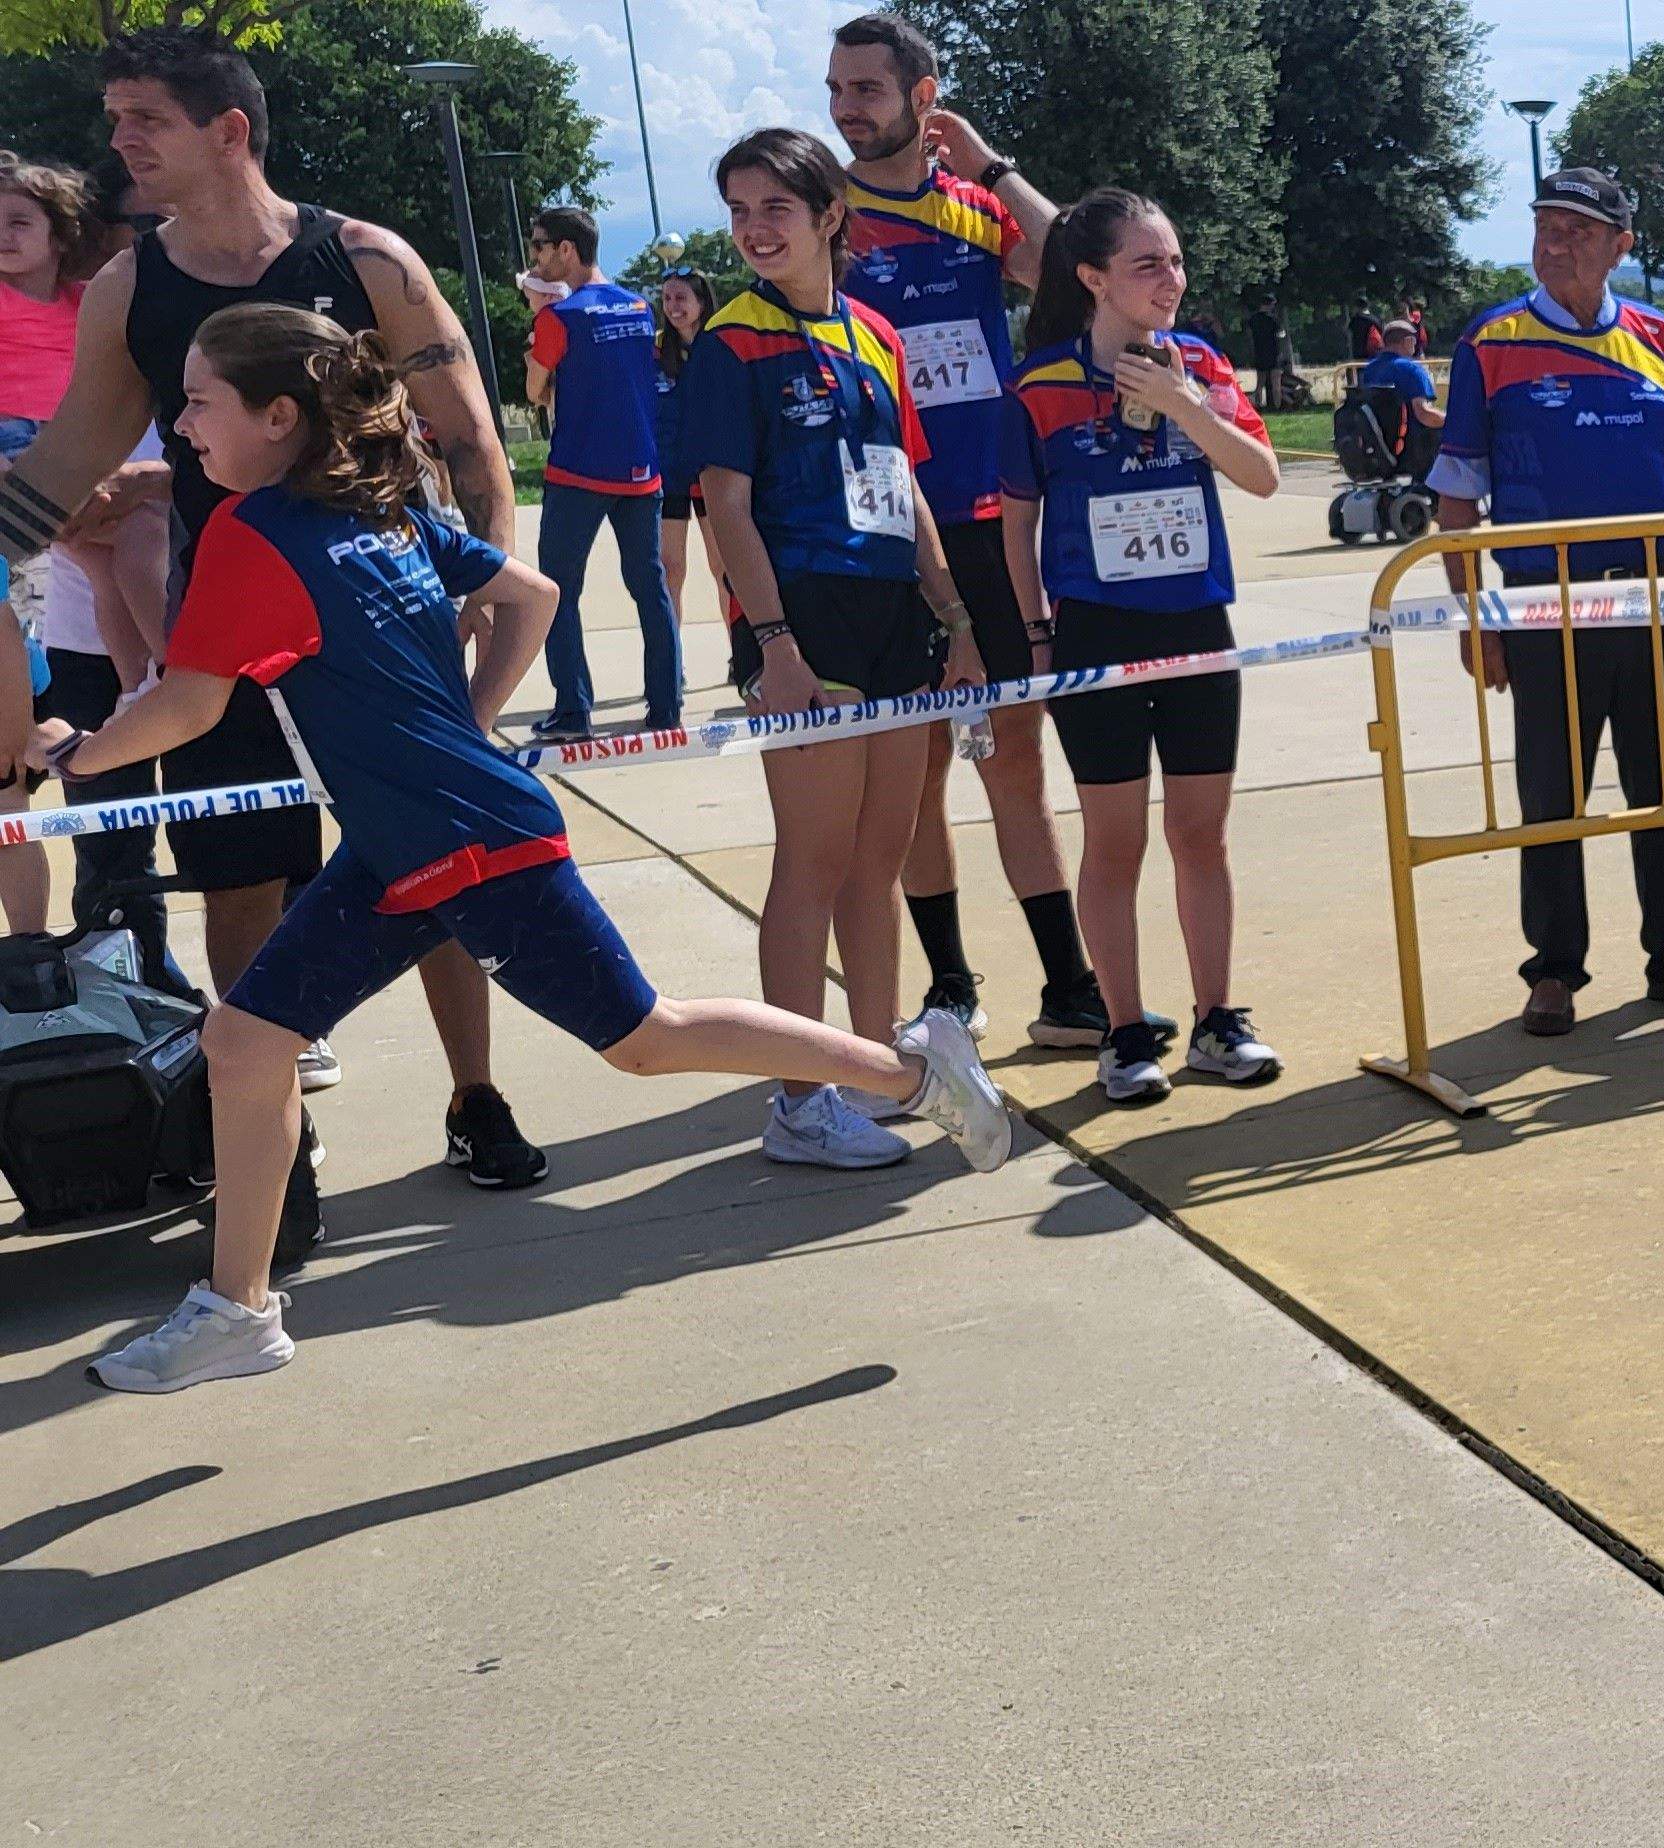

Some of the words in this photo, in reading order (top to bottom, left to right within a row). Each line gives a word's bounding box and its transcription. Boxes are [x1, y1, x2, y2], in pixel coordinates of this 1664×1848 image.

[913, 361, 970, 391] 417
[1603, 410, 1645, 427] mupol
[1123, 531, 1191, 562] 416
[746, 702, 842, 737] POLICIA
[560, 732, 645, 765] PASAR
[98, 795, 217, 831] POLICIA
[225, 788, 263, 814] DE
